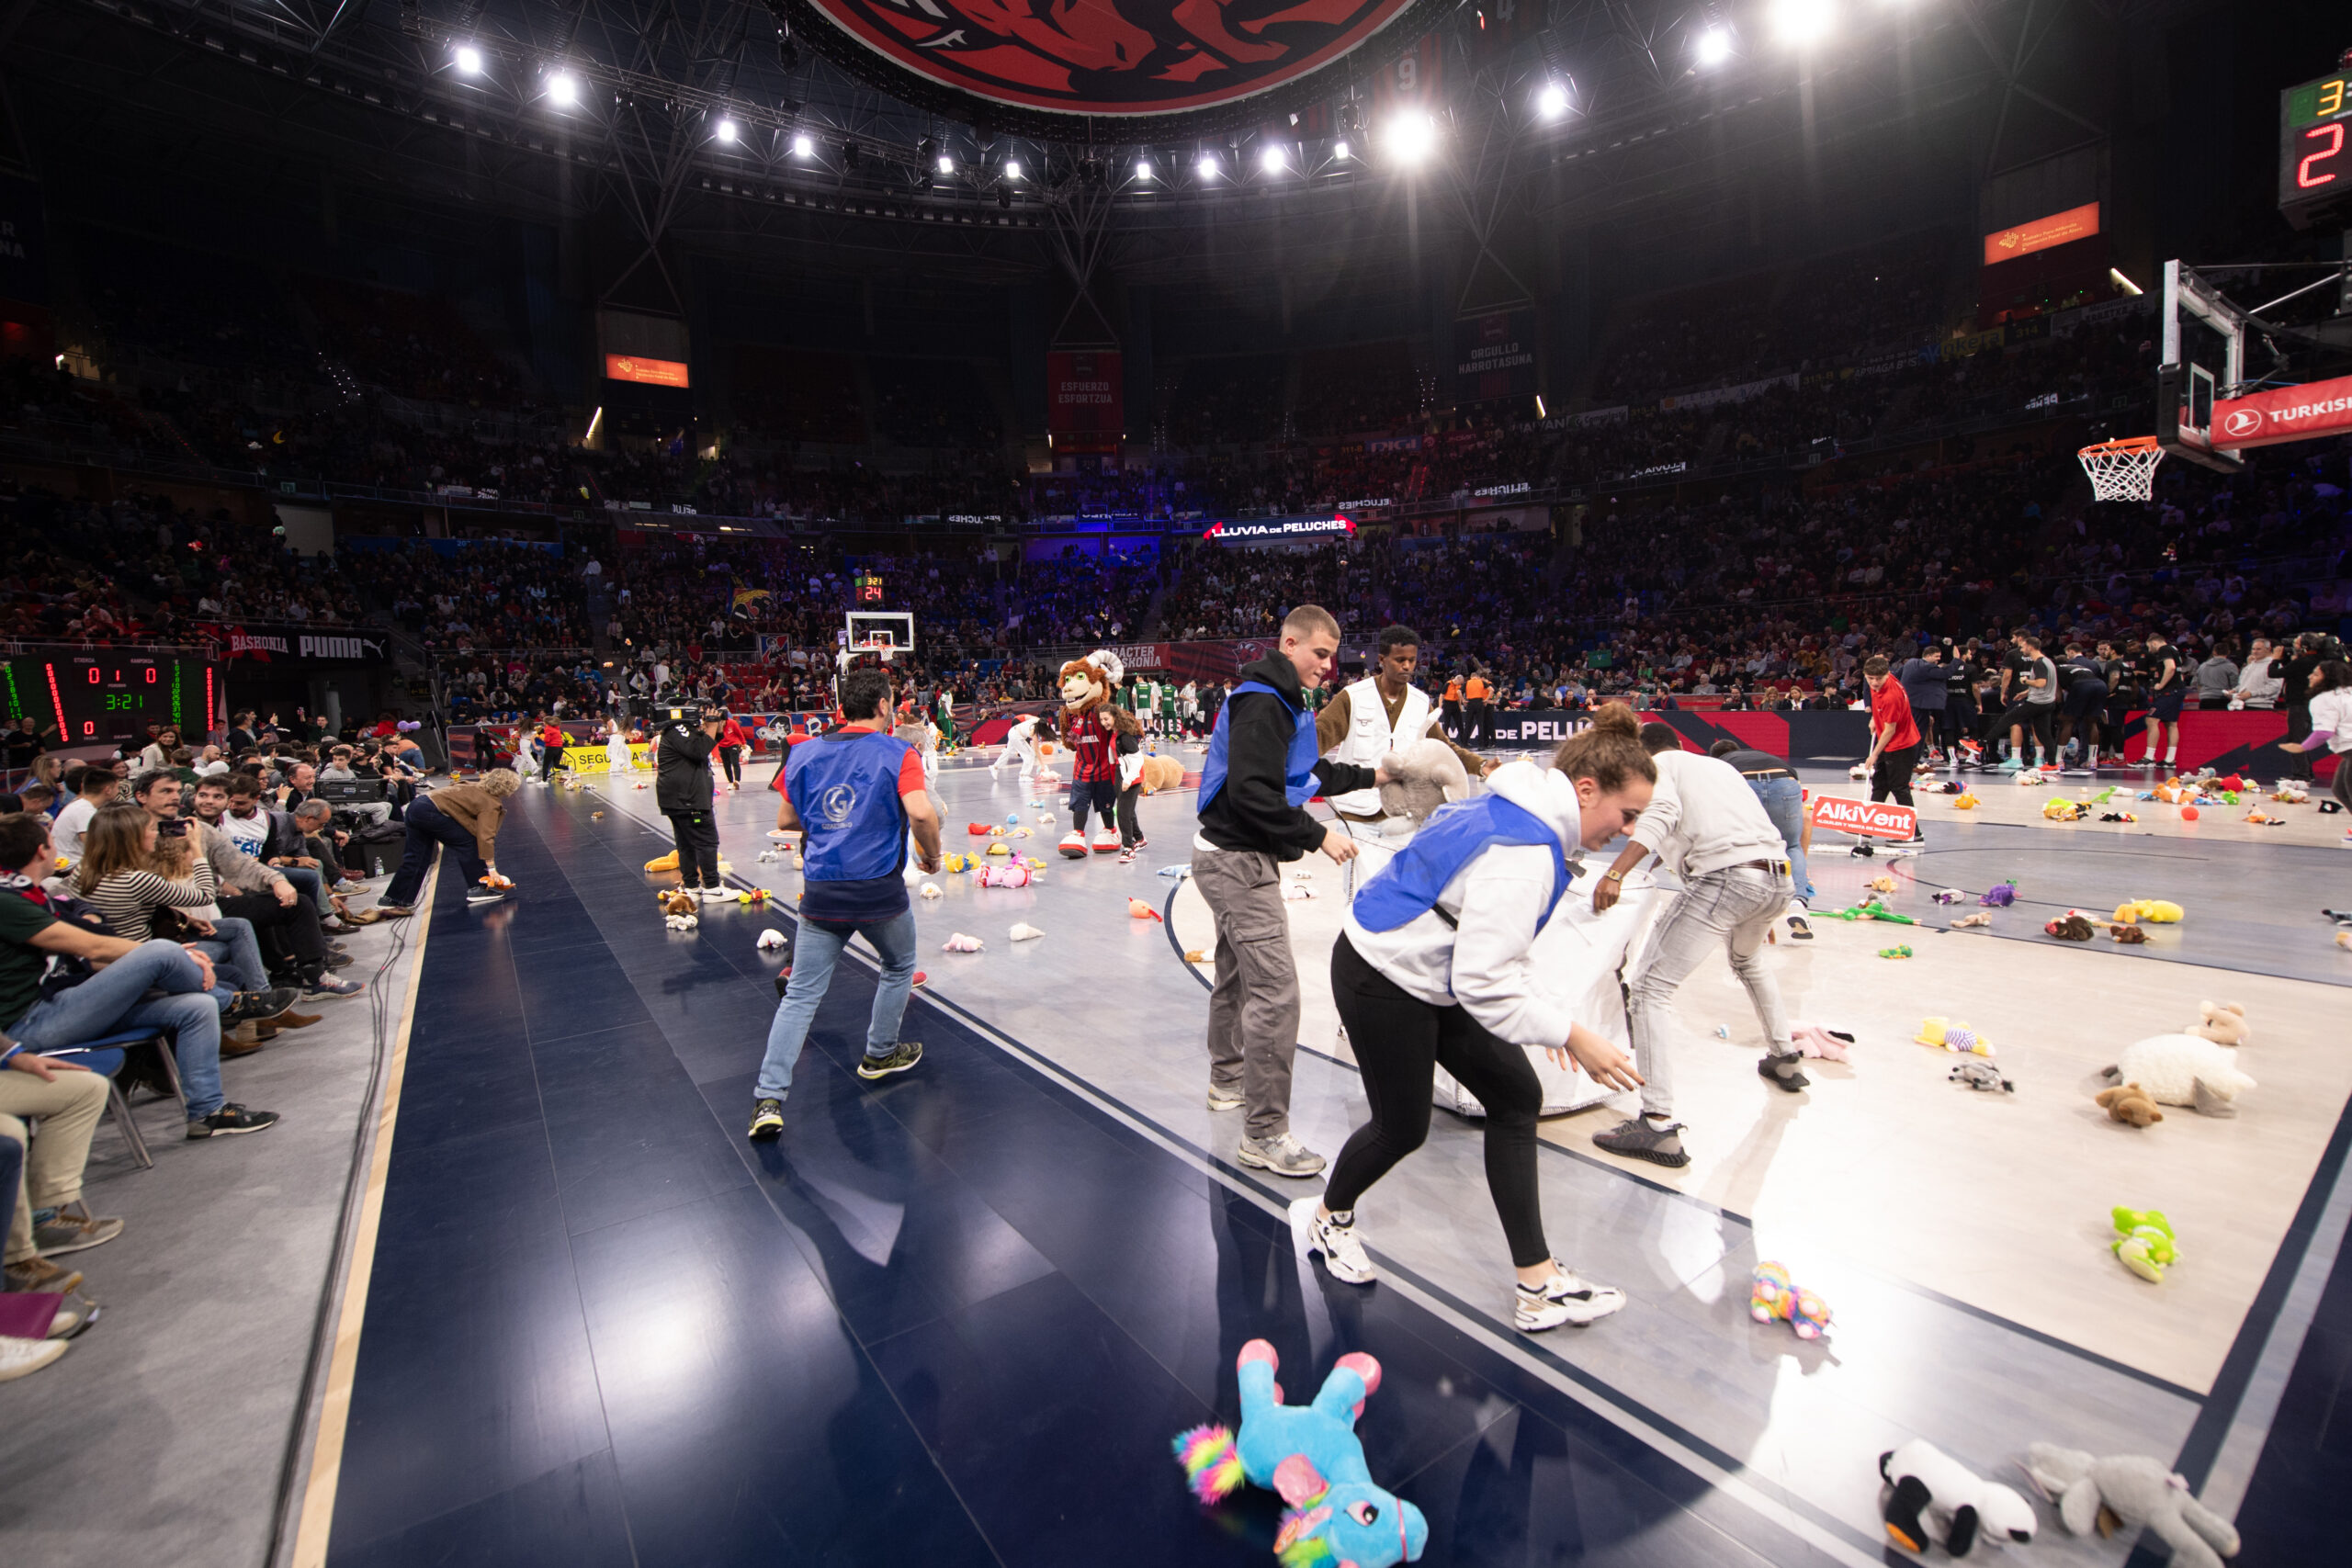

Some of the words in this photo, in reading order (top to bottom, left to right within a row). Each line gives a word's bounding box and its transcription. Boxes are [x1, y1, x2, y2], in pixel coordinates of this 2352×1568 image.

[1398, 58, 1417, 90] 9
[2298, 123, 2345, 188] 2
[2015, 325, 2038, 339] 314
[1471, 343, 1519, 360] ORGULLO
[1458, 353, 1533, 375] HARROTASUNA
[1060, 381, 1110, 392] ESFUERZO
[1057, 393, 1114, 405] ESFORTZUA
[1212, 525, 1268, 537] LLUVIA
[1283, 520, 1345, 533] PELUCHES
[865, 586, 882, 600] 24
[231, 635, 289, 653] BASKONIA
[300, 635, 363, 659] PUMA
[1121, 656, 1161, 669] SKONIA
[89, 667, 100, 683] 0
[146, 667, 157, 683] 0
[106, 694, 143, 710] 3:21
[84, 721, 95, 735] 0
[1495, 728, 1517, 739] DE
[1815, 801, 1912, 829] AlkiVent
[1816, 818, 1843, 828] ALQUILER
[1874, 827, 1909, 837] MAQUINARIA
